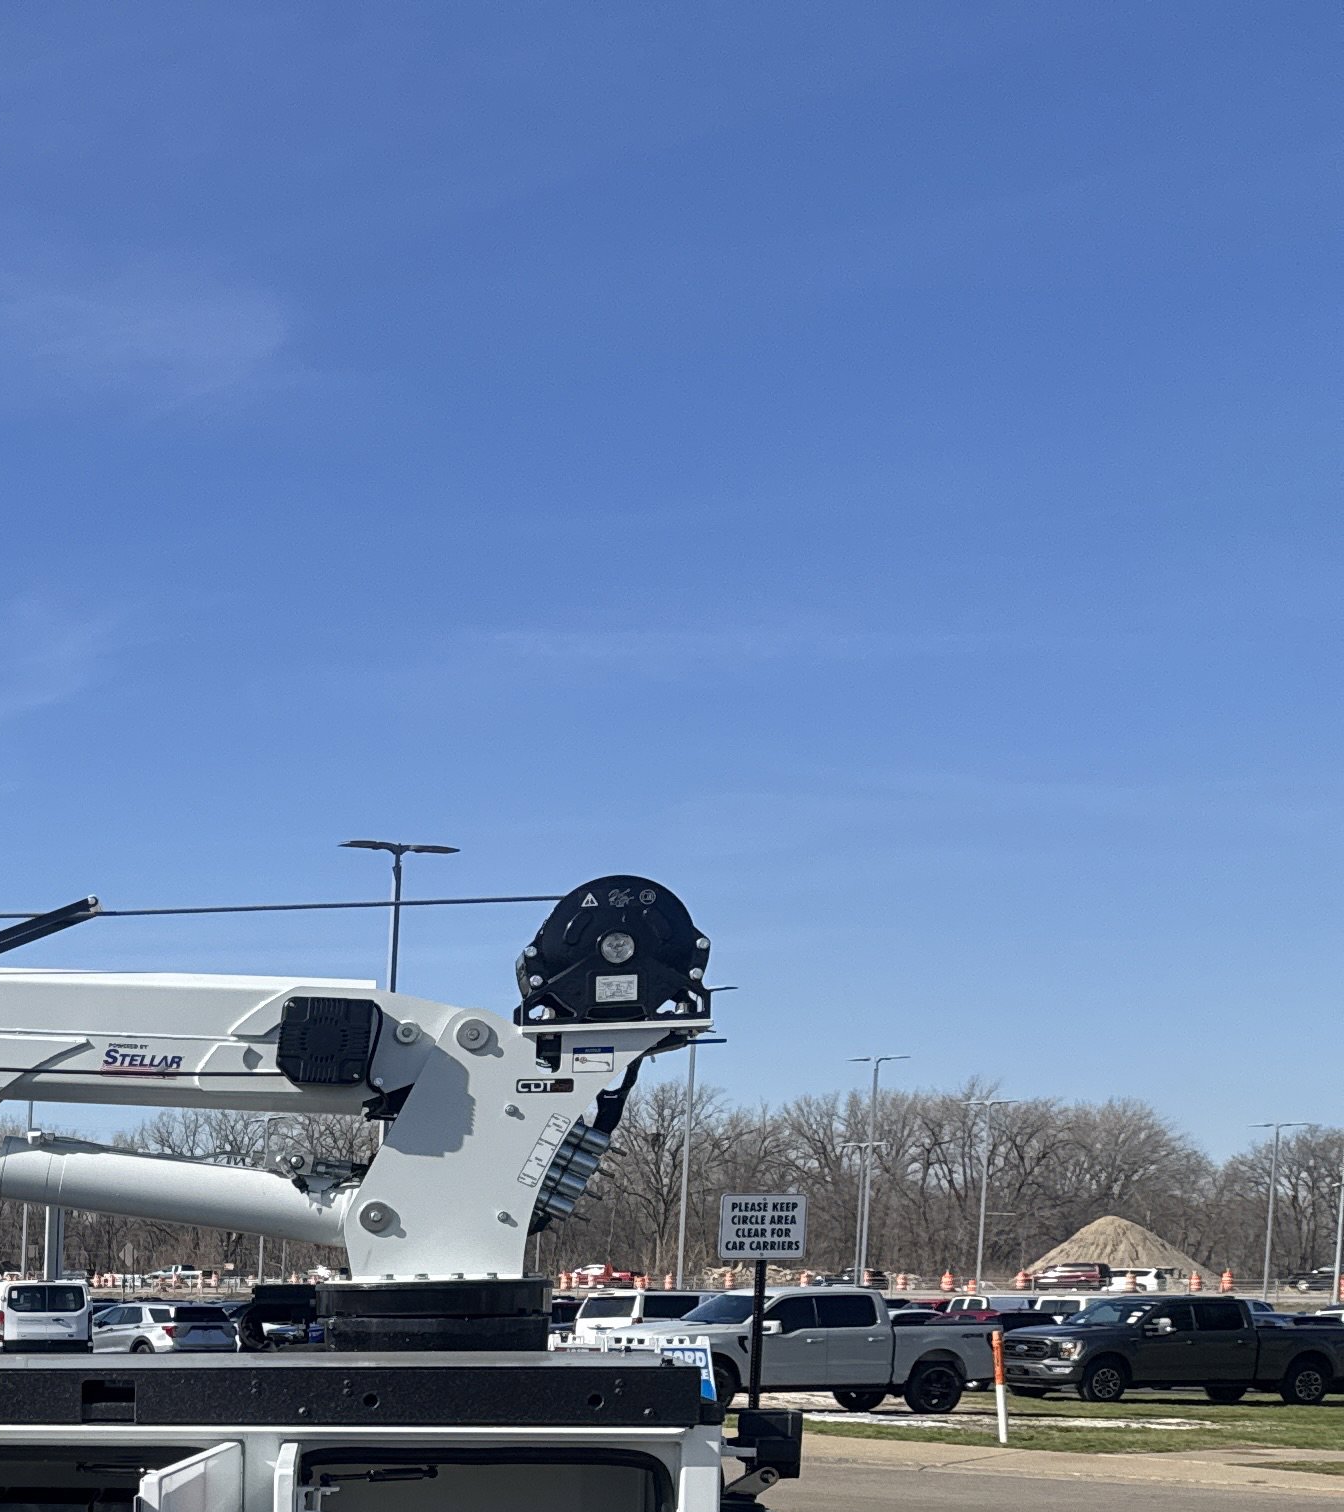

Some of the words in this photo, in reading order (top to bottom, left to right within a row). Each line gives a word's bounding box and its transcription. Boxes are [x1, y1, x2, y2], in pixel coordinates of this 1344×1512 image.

[103, 1048, 184, 1069] STELLAR
[517, 1079, 556, 1092] CDT
[731, 1202, 769, 1213] PLEASE
[772, 1202, 799, 1213] KEEP
[731, 1214, 766, 1225] CIRCLE
[769, 1214, 797, 1225] AREA
[735, 1227, 767, 1238] CLEAR
[770, 1227, 791, 1238] FOR
[725, 1240, 746, 1251] CAR
[749, 1240, 800, 1251] CARRIERS
